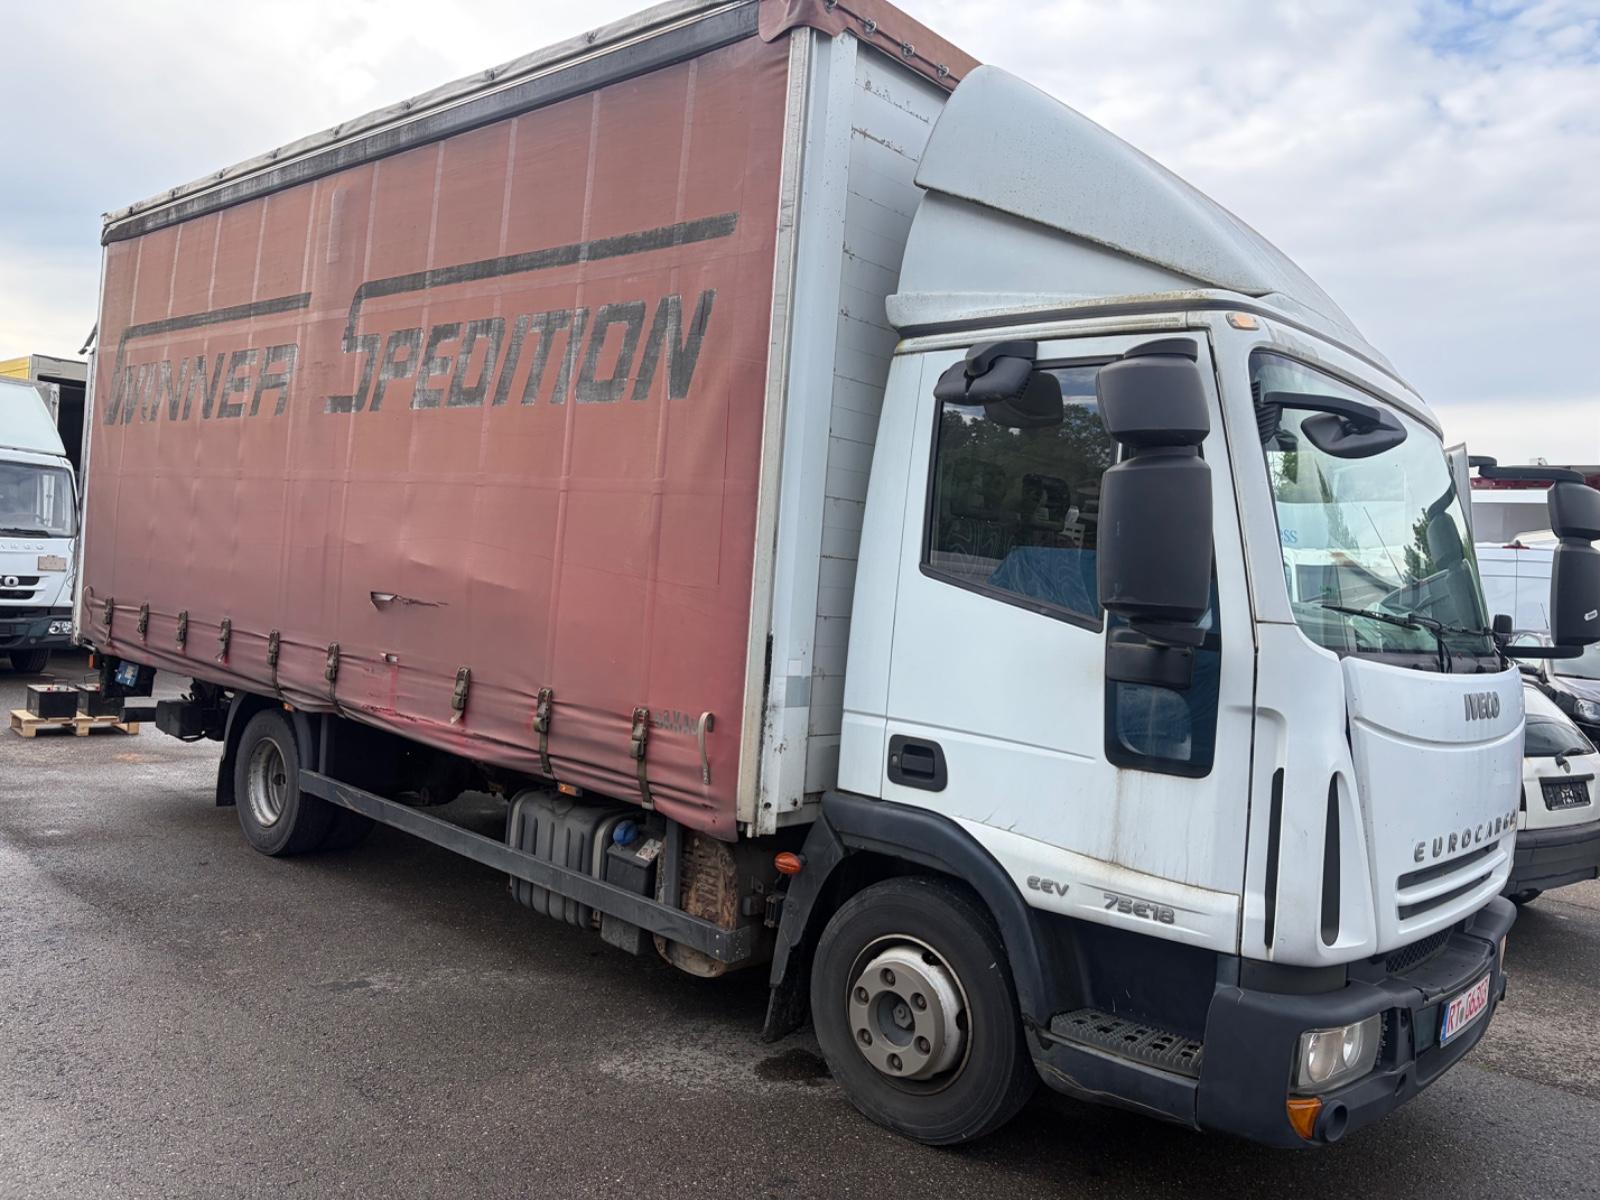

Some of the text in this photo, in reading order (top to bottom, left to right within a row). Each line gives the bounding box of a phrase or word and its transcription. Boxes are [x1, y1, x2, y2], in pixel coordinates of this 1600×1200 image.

[324, 283, 716, 414] SPEDITION
[1464, 691, 1500, 722] IVECO
[1027, 875, 1070, 897] EEV
